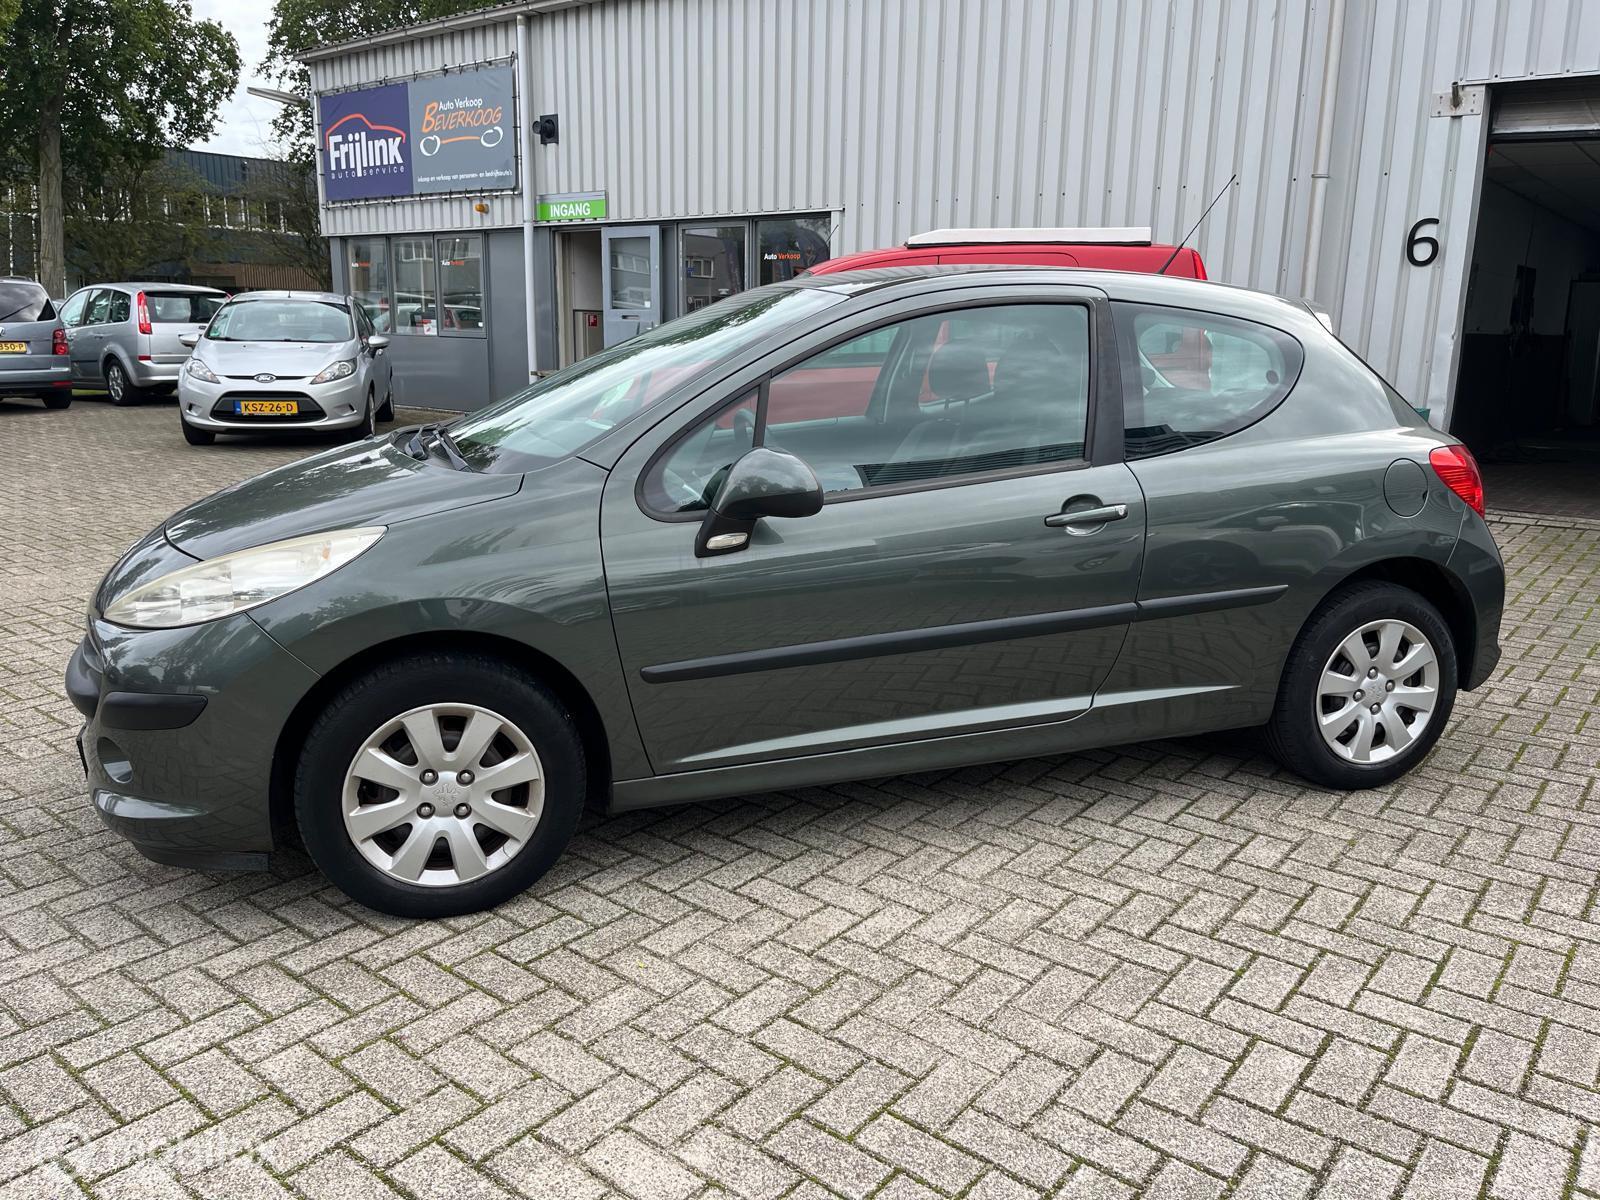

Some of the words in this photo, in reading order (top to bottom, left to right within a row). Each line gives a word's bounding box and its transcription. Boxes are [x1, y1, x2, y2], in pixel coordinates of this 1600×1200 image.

[439, 101, 454, 111] Auto
[454, 97, 483, 108] Verkoop
[329, 131, 404, 178] Frijlink
[550, 202, 591, 217] INGANG
[1407, 217, 1440, 267] 6
[778, 252, 801, 260] Verkoop
[244, 402, 294, 412] KSZ-26-D
